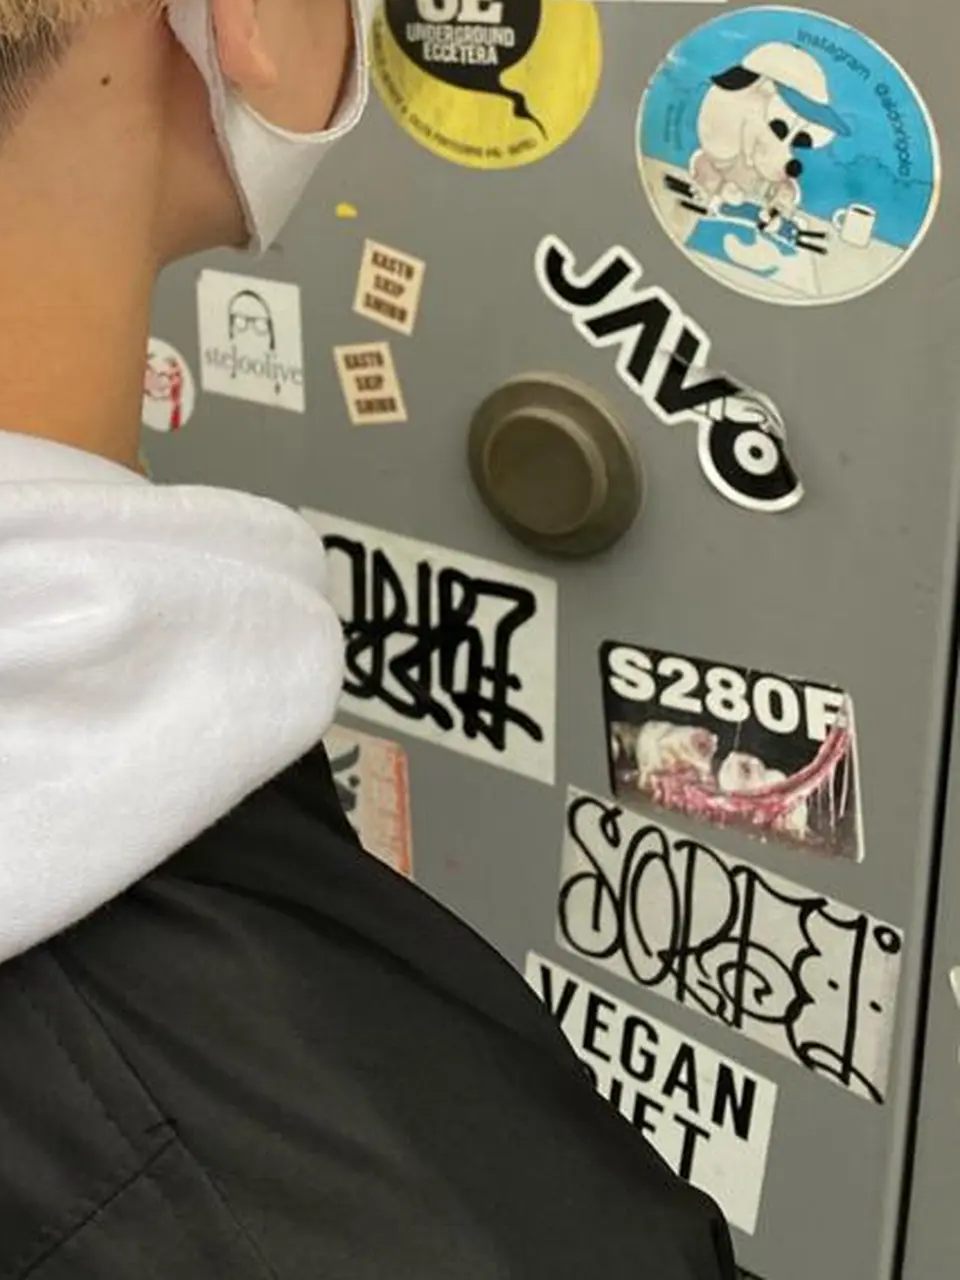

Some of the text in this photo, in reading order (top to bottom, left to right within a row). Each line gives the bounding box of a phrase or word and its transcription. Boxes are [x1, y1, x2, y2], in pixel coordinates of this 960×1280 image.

[406, 22, 515, 48] UNDERGROUND
[423, 41, 498, 65] ECCETERA
[541, 964, 757, 1142] VEGAN
